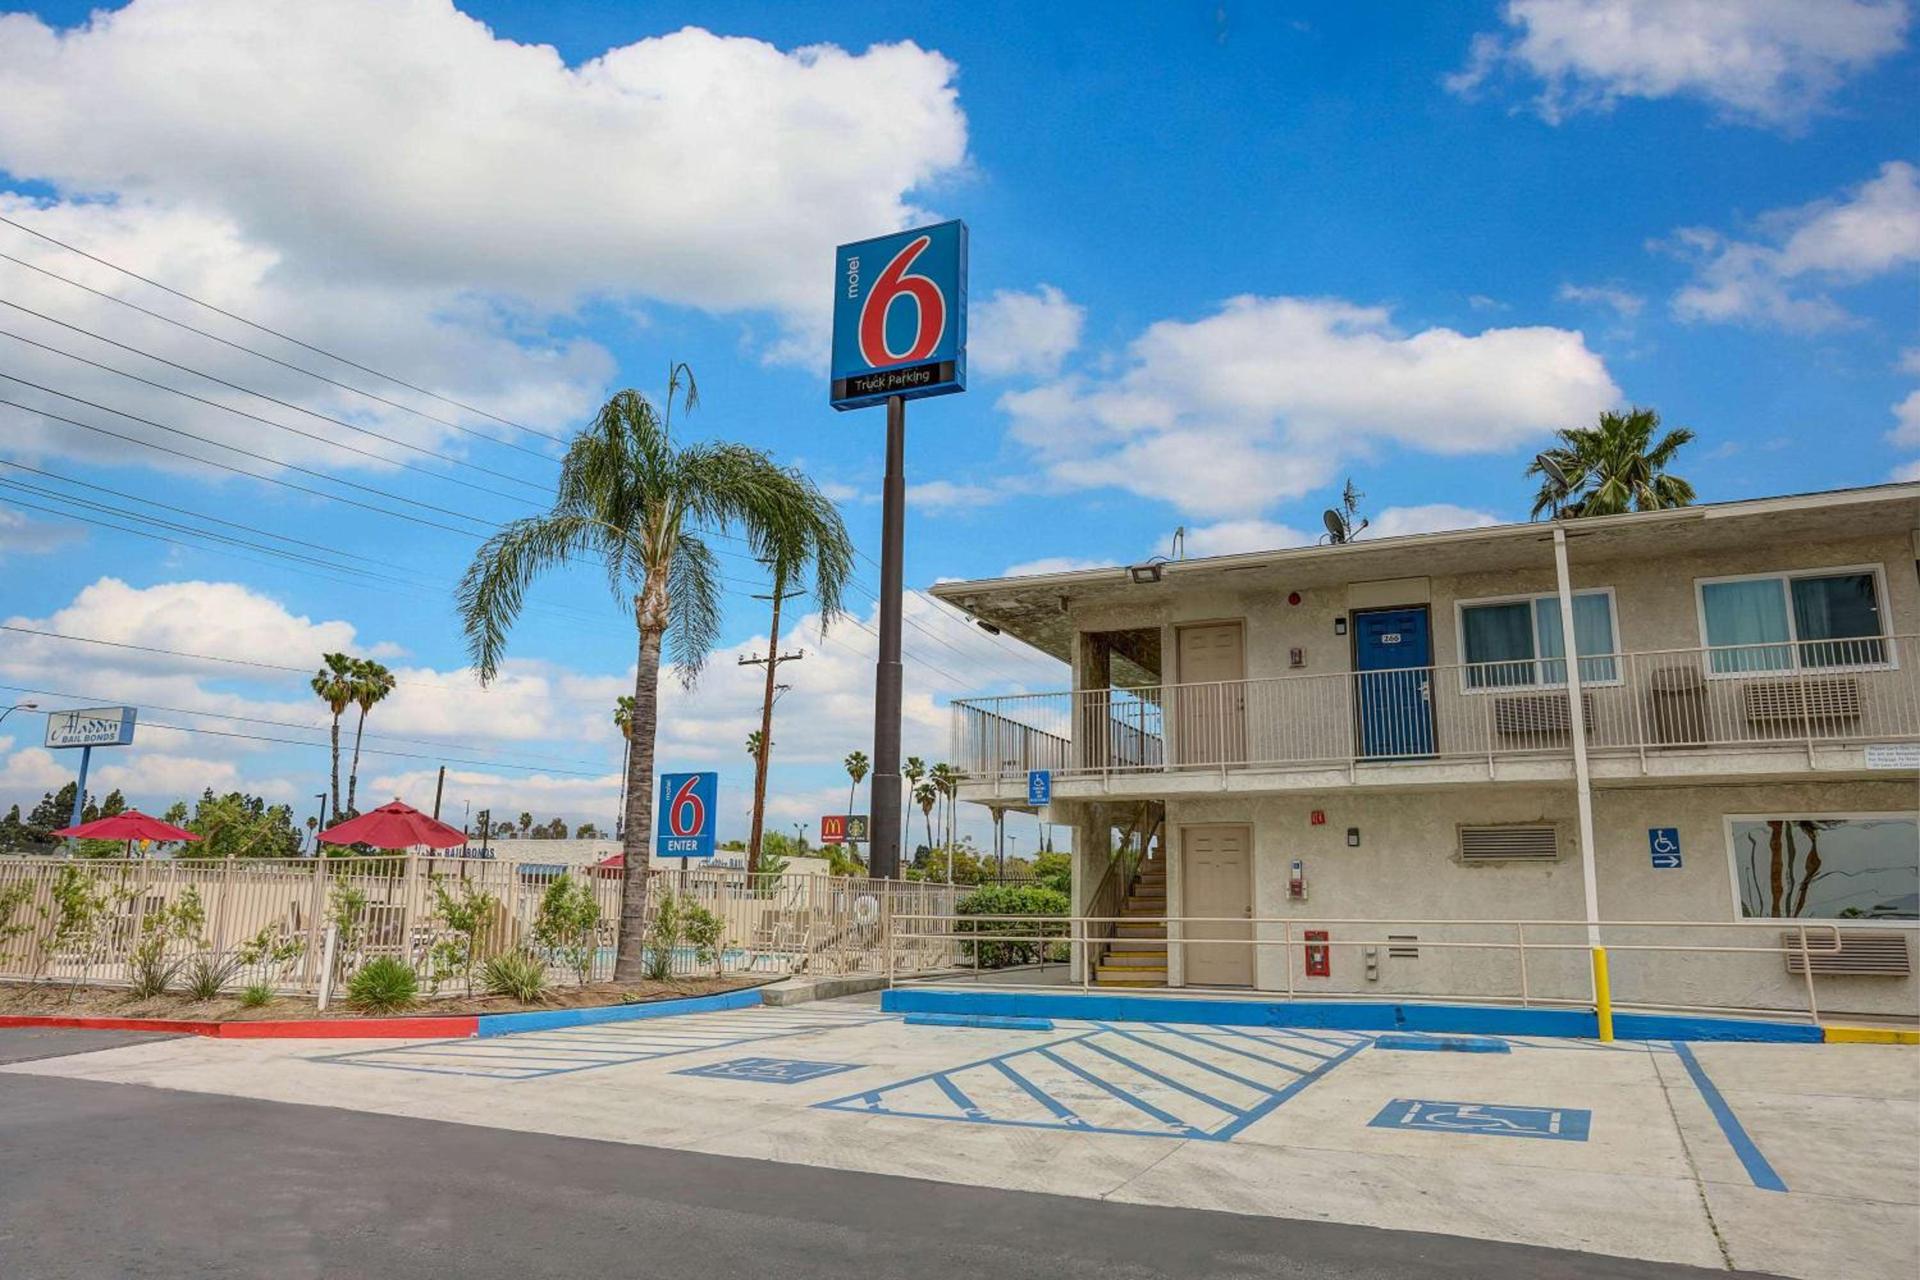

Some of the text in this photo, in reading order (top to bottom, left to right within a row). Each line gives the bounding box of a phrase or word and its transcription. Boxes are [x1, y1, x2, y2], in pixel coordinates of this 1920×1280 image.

[847, 256, 860, 300] motel
[858, 235, 947, 368] 6
[854, 370, 930, 391] Truck Parking
[51, 712, 118, 741] Aladdin
[62, 733, 115, 743] BAIL BONDS
[669, 775, 705, 837] 6
[445, 848, 463, 858] BAIL
[465, 847, 496, 859] BONDS
[668, 839, 698, 851] ENTER
